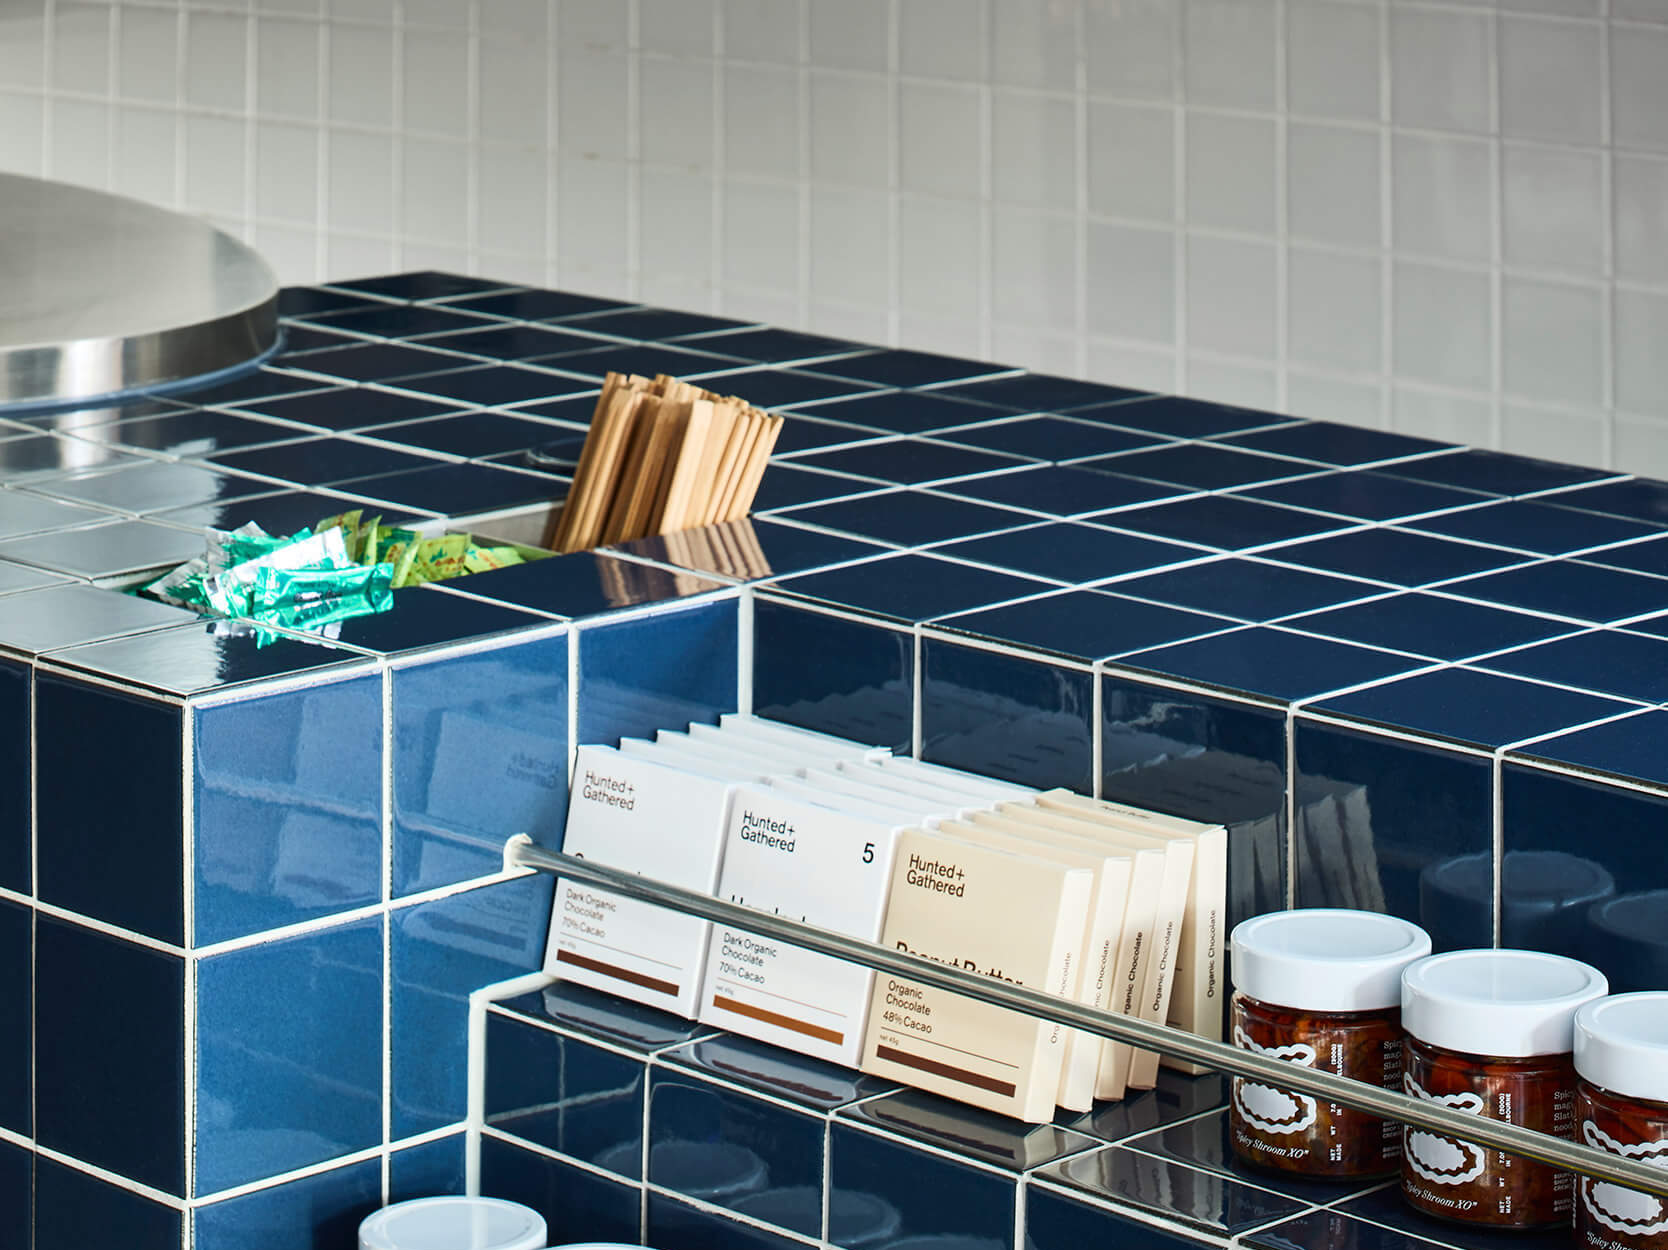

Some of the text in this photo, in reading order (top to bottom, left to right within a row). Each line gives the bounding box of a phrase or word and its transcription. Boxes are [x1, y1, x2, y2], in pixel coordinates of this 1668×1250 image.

[583, 784, 635, 812] Gathered
[739, 826, 796, 854] Gathered
[861, 841, 875, 864] 5
[905, 869, 966, 898] Gathered
[564, 901, 605, 922] Chocolate
[566, 887, 617, 913] Dark Organic
[579, 922, 606, 938] Cacao
[721, 944, 765, 967] Chocolate
[723, 931, 777, 958] Dark Organic
[1206, 909, 1217, 998] Organic Chocolate
[737, 967, 766, 984] Cacao
[1060, 951, 1072, 997] hocolate
[1096, 939, 1110, 990] Chocolate
[1122, 931, 1143, 1015] rganic Chocolate
[1152, 920, 1174, 1012] Organic Chocolate
[888, 980, 923, 1000] Organic
[885, 993, 932, 1017] Chocolate
[882, 1011, 934, 1034] 48% Cacao
[1253, 1139, 1287, 1158] Shroom
[1421, 1189, 1455, 1208] Shroom
